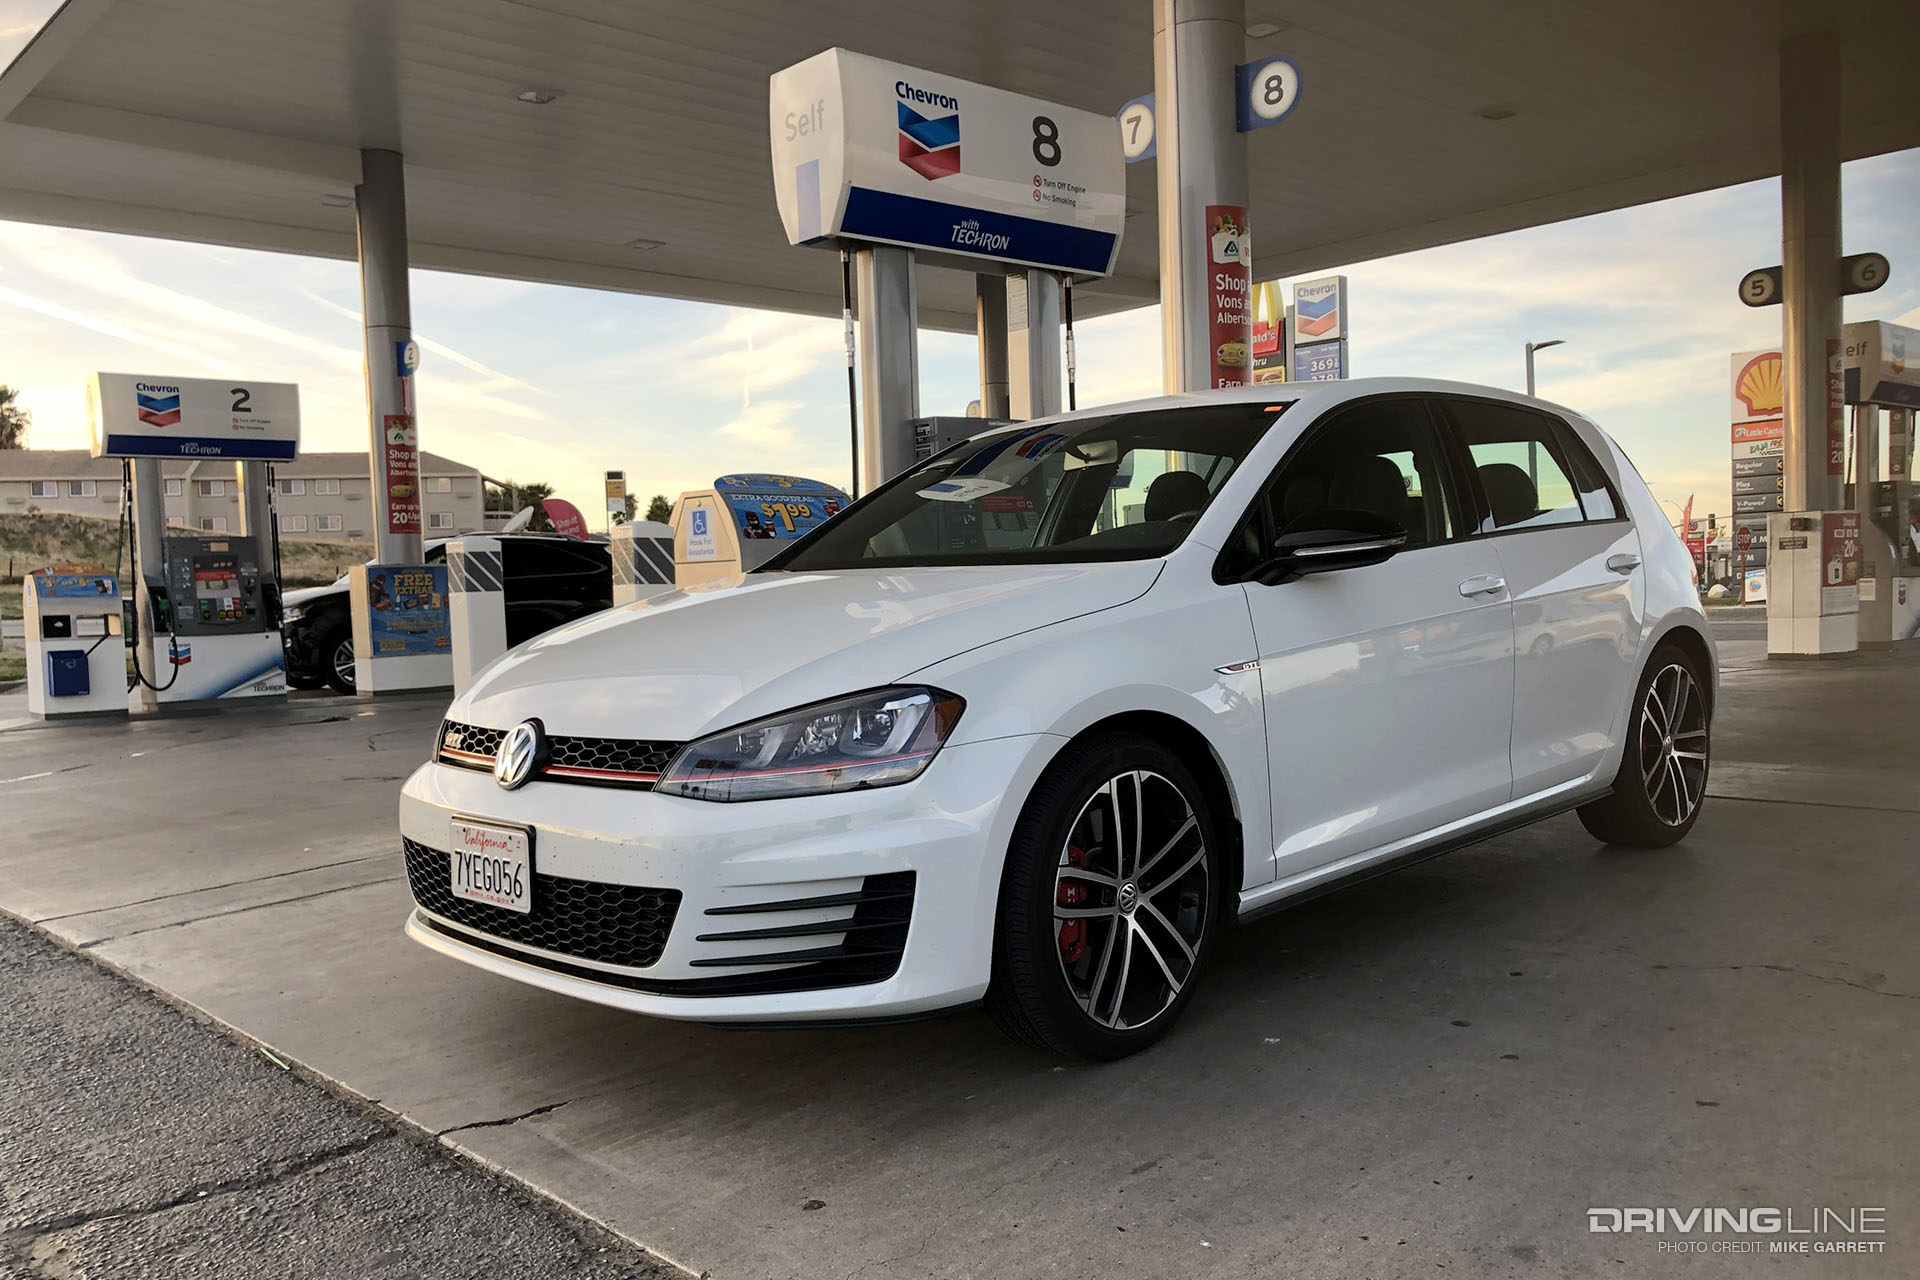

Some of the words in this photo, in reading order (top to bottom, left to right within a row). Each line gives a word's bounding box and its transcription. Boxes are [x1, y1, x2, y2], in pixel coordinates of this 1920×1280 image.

[895, 80, 959, 112] Chevron
[1264, 75, 1283, 105] 8
[784, 99, 825, 142] Self
[1126, 115, 1142, 145] 7
[1032, 115, 1062, 167] 8
[1043, 178, 1056, 188] Turn
[1057, 181, 1067, 191] Off
[1067, 183, 1086, 194] Engine
[1042, 193, 1051, 201] No
[1052, 195, 1077, 207] Smoking
[961, 219, 980, 231] with
[951, 225, 1010, 251] TECHRON
[1861, 263, 1876, 282] 6
[1215, 273, 1246, 293] Shop
[1751, 279, 1765, 297] 5
[1296, 283, 1337, 298] Chevron
[1216, 294, 1242, 309] Vons
[1216, 312, 1250, 325] Alberts
[1253, 331, 1276, 344] ald's
[407, 347, 414, 360] 2
[1845, 341, 1868, 357] elf
[1252, 357, 1267, 367] hru
[136, 382, 179, 393] Chevron
[230, 388, 252, 413] 2
[180, 444, 222, 455] TECHRON
[1770, 440, 1784, 448] FRE
[389, 449, 409, 462] Shop
[389, 460, 408, 469] Vons
[1736, 462, 1764, 470] Regular
[731, 494, 762, 502] EXTRA
[791, 495, 814, 503] DEAL
[1736, 499, 1766, 508] V-Power
[690, 538, 703, 546] Honk
[704, 538, 712, 546] For
[1737, 534, 1751, 543] STOP
[688, 547, 715, 557] Assistance
[394, 574, 433, 587] FREE
[1242, 661, 1261, 671] GTI
[465, 827, 512, 853] California
[454, 849, 523, 899] 7YEG056
